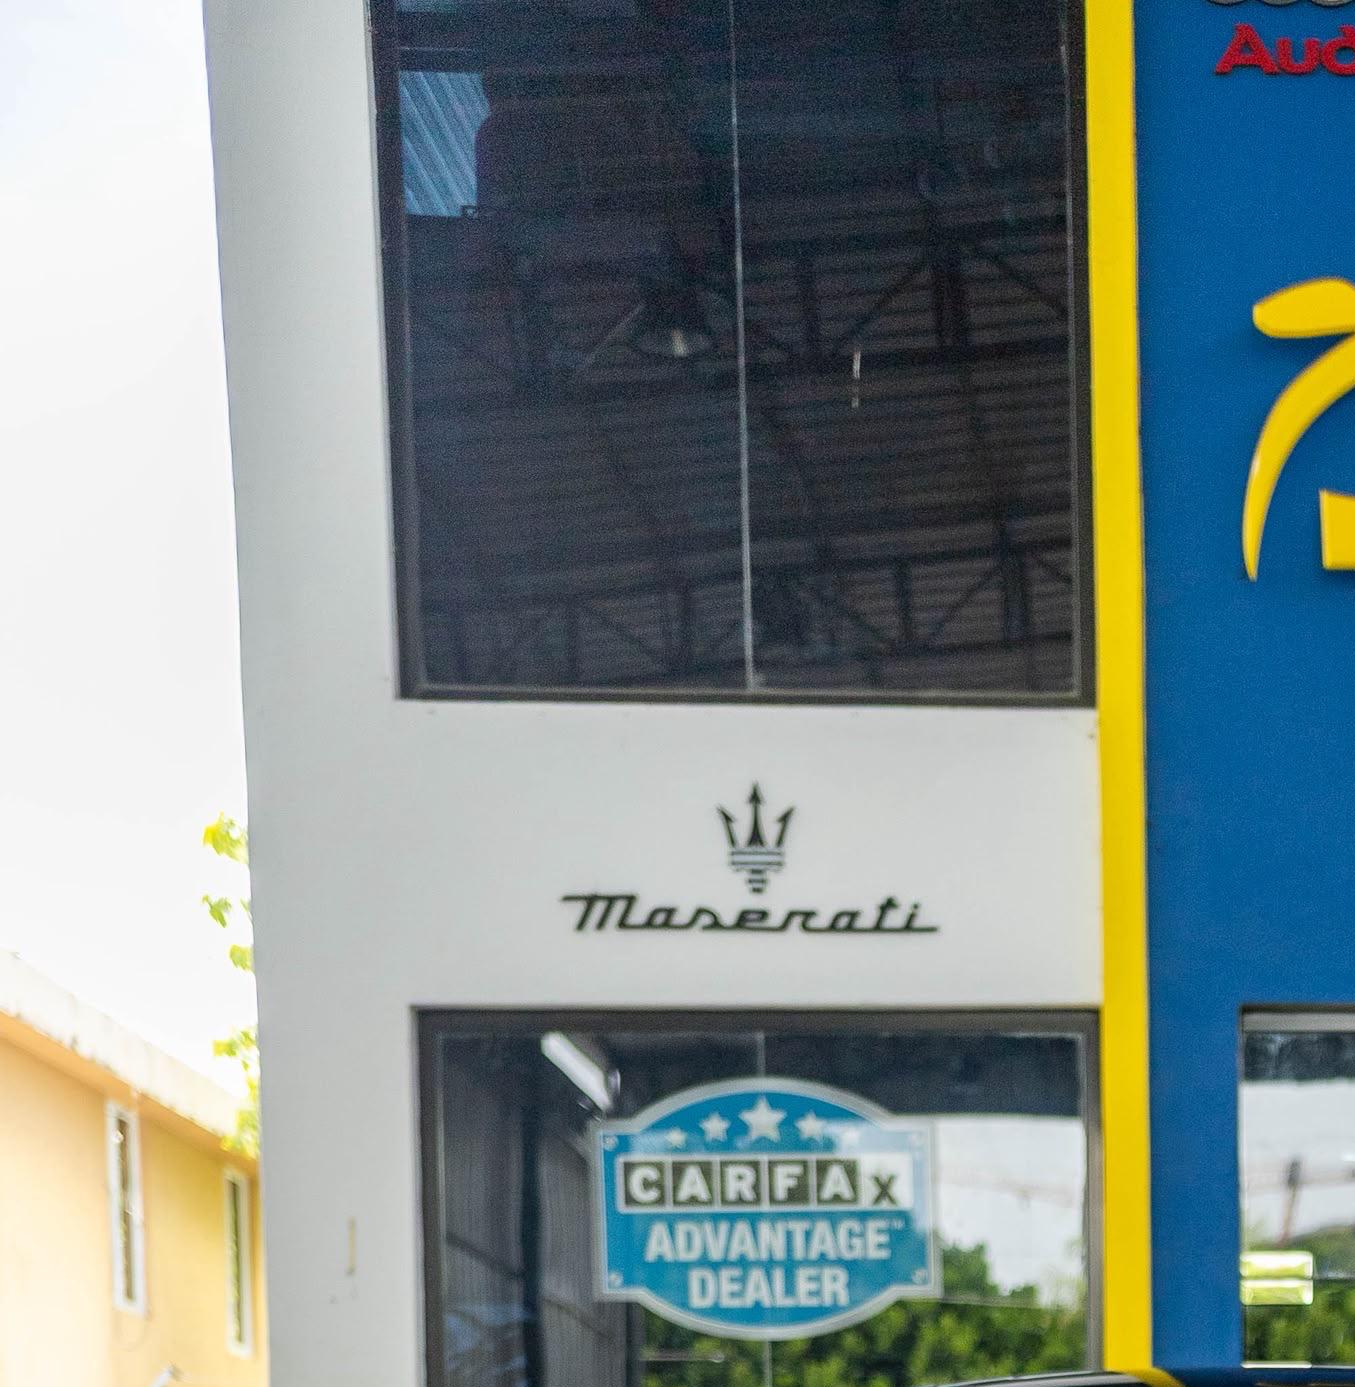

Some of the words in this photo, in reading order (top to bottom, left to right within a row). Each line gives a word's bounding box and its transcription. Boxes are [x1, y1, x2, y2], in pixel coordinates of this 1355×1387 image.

[559, 894, 940, 933] Maserati
[625, 1160, 898, 1206] CARFAX
[688, 1266, 849, 1308] DEALER
